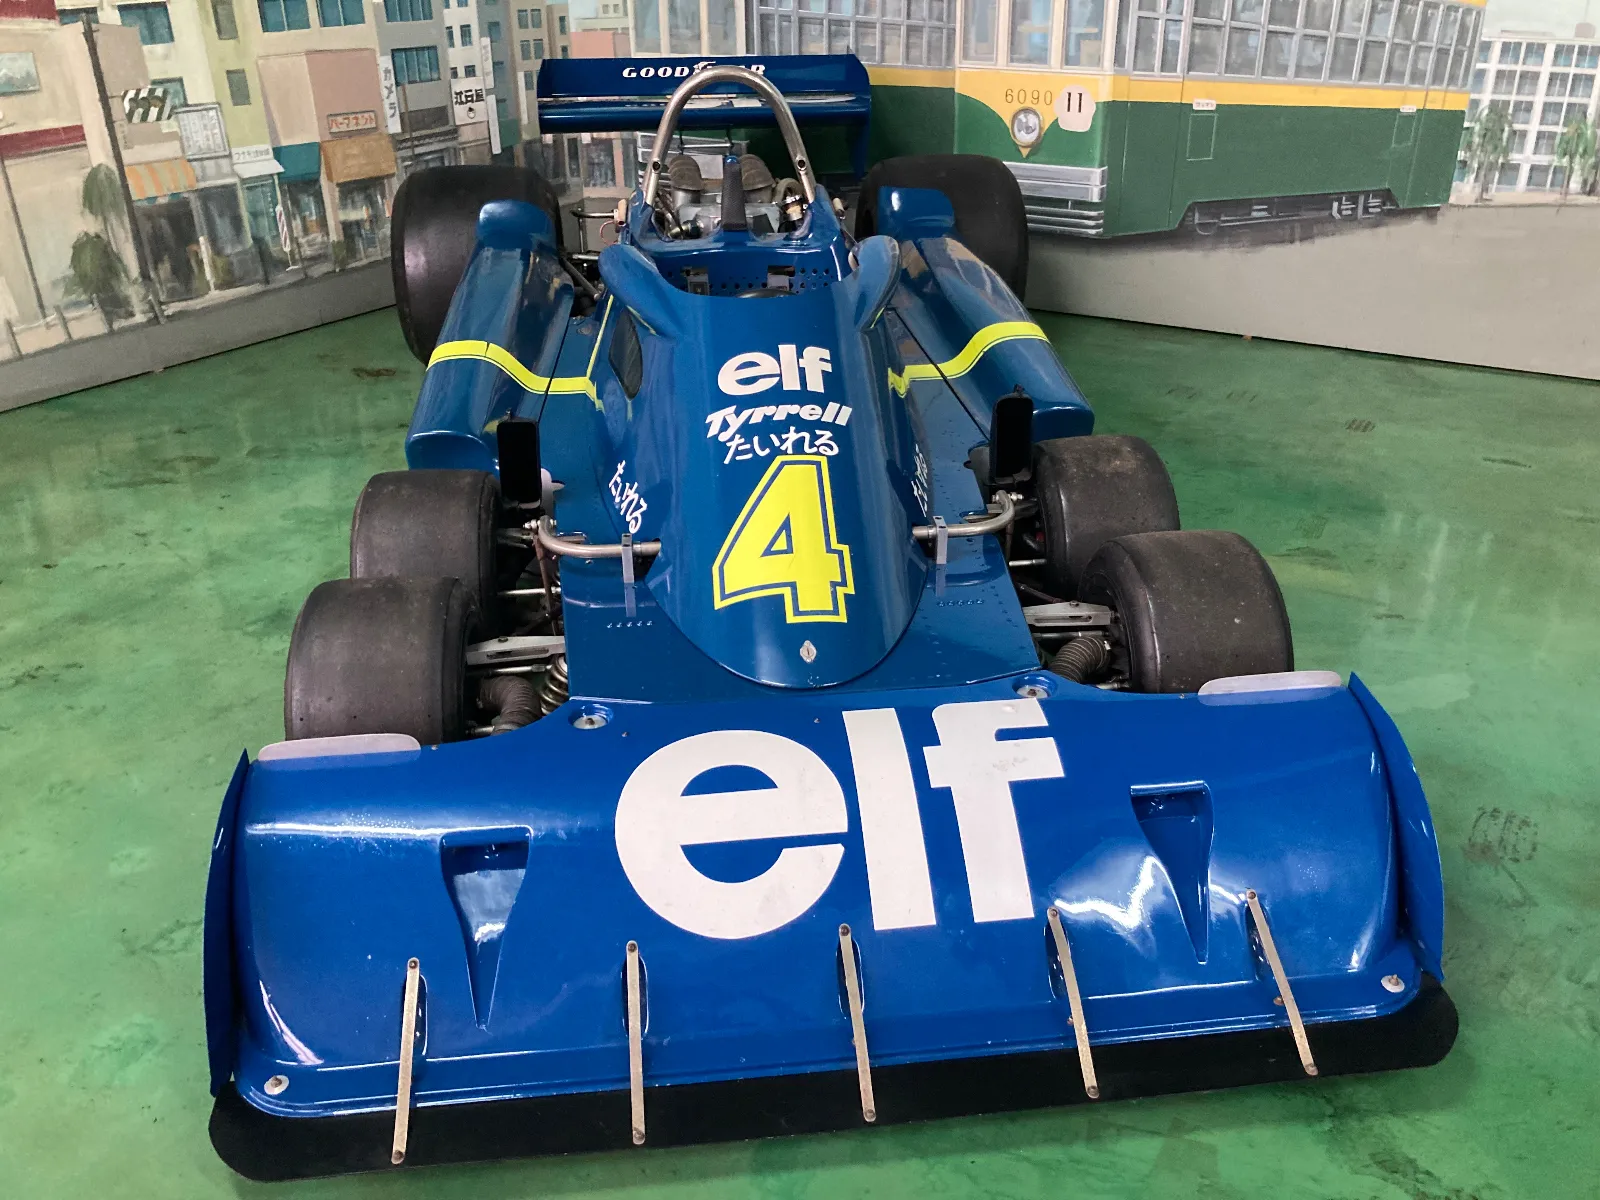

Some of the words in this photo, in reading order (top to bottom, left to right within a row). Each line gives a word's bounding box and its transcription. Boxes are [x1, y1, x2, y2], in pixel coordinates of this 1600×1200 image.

[622, 63, 766, 78] GOODR
[1005, 88, 1053, 106] 6090
[1066, 92, 1083, 113] 11
[717, 344, 832, 396] elf
[705, 402, 853, 442] Tyrrell
[723, 426, 839, 464] たいれる
[609, 460, 648, 534] たいれる
[712, 454, 855, 624] 4
[614, 697, 1066, 940] elf
